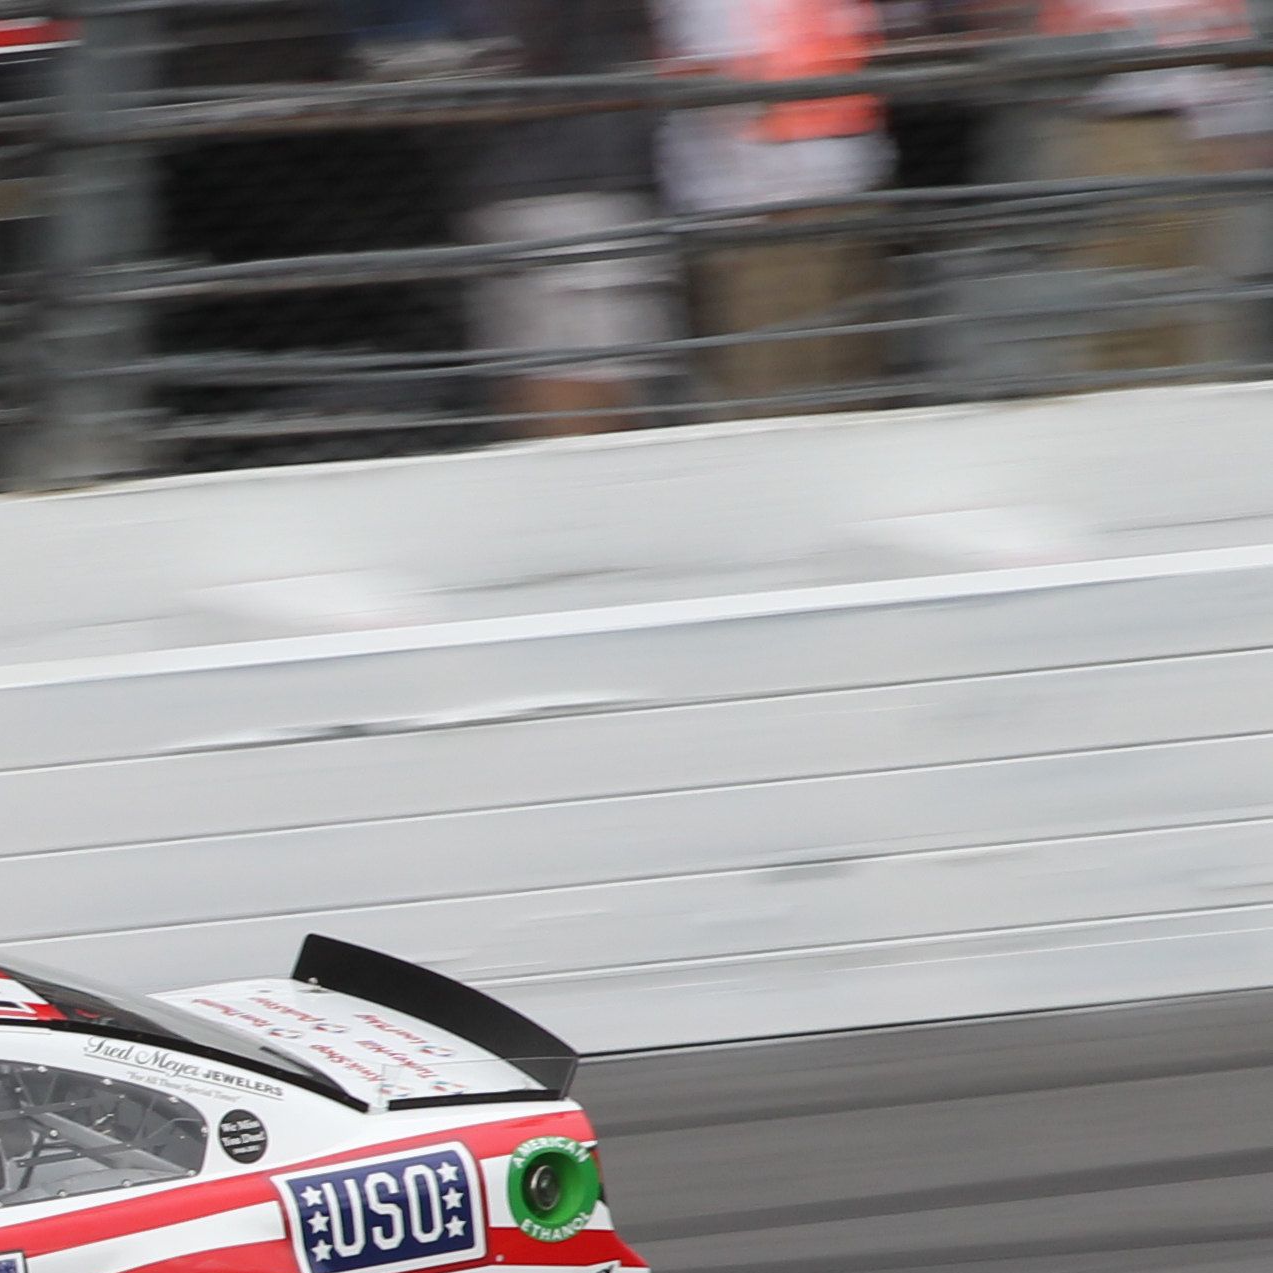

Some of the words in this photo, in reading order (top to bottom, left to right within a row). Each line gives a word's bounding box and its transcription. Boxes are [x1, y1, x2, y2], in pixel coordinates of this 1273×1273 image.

[204, 1070, 285, 1098] JEWELERS
[513, 1136, 591, 1169] AMERICAN
[318, 1162, 447, 1260] USO
[520, 1211, 591, 1241] ETHANOL
